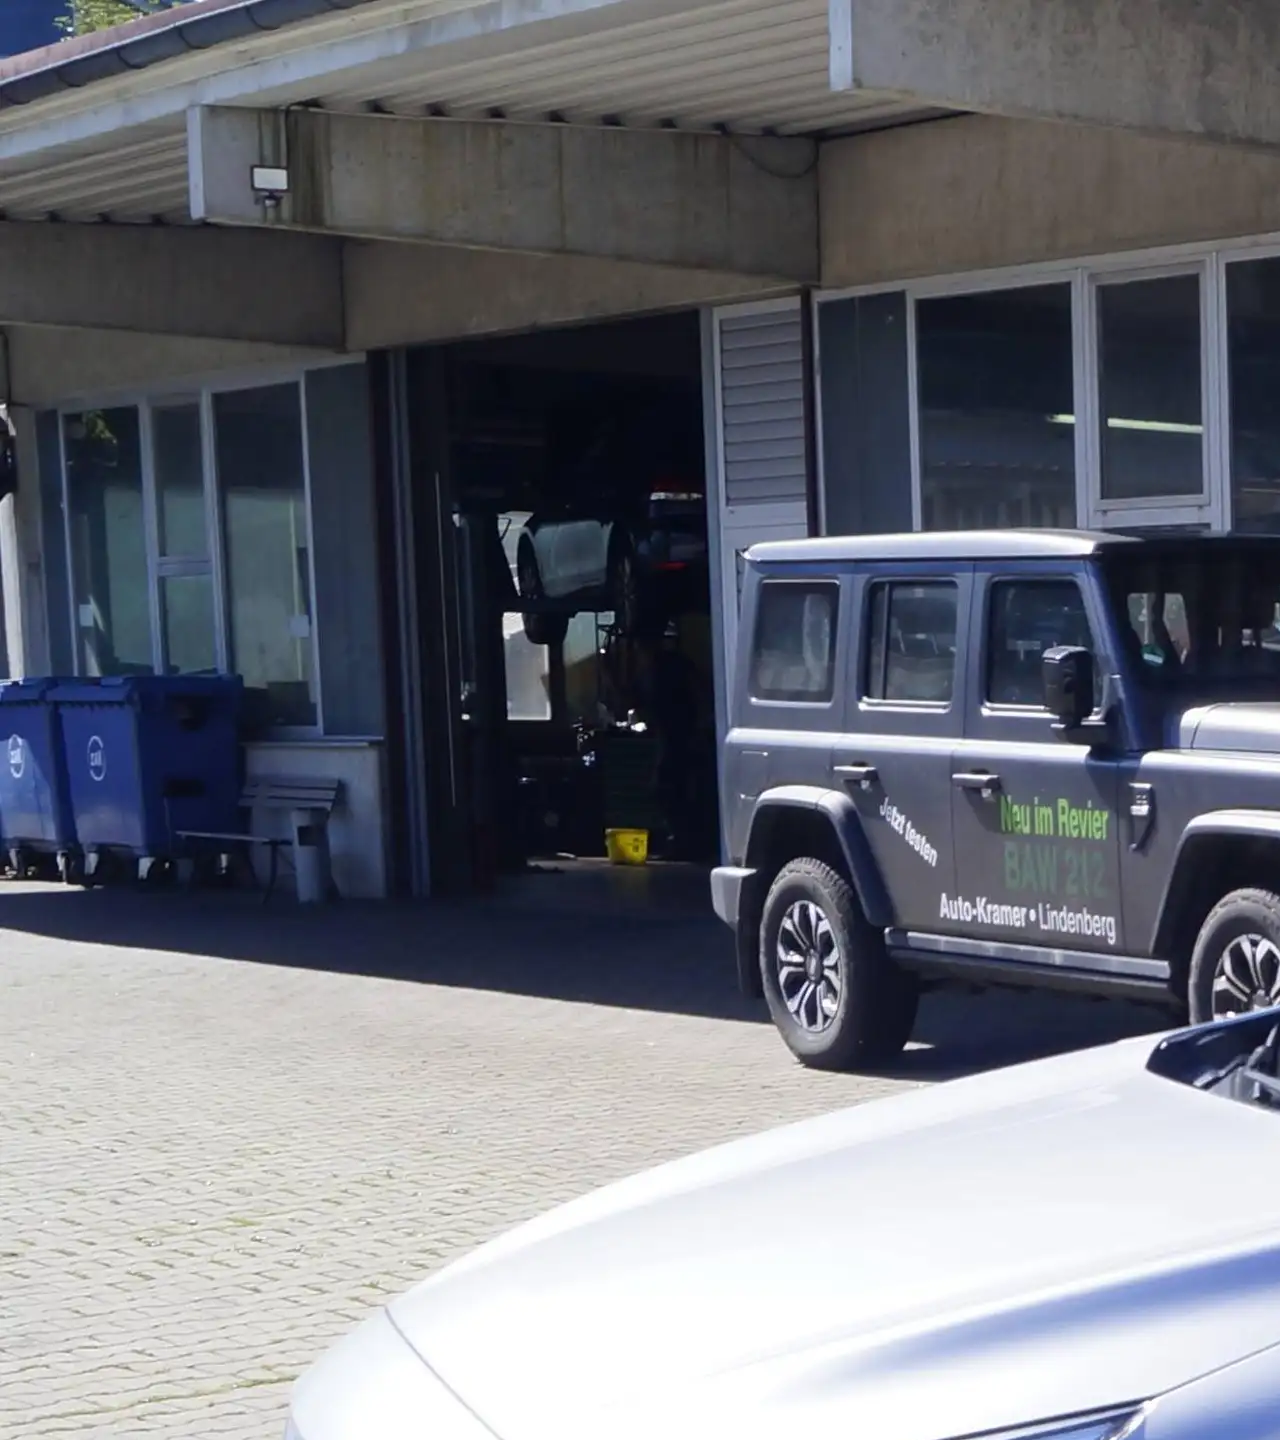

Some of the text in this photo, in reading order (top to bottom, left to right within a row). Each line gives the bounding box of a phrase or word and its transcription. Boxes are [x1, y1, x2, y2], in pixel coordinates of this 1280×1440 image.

[879, 797, 938, 868] Jetzt testen
[1001, 795, 1109, 840] Neu im Revier
[1004, 841, 1057, 895] BAW
[939, 892, 1116, 945] Auto-Kramer Lindenberg
